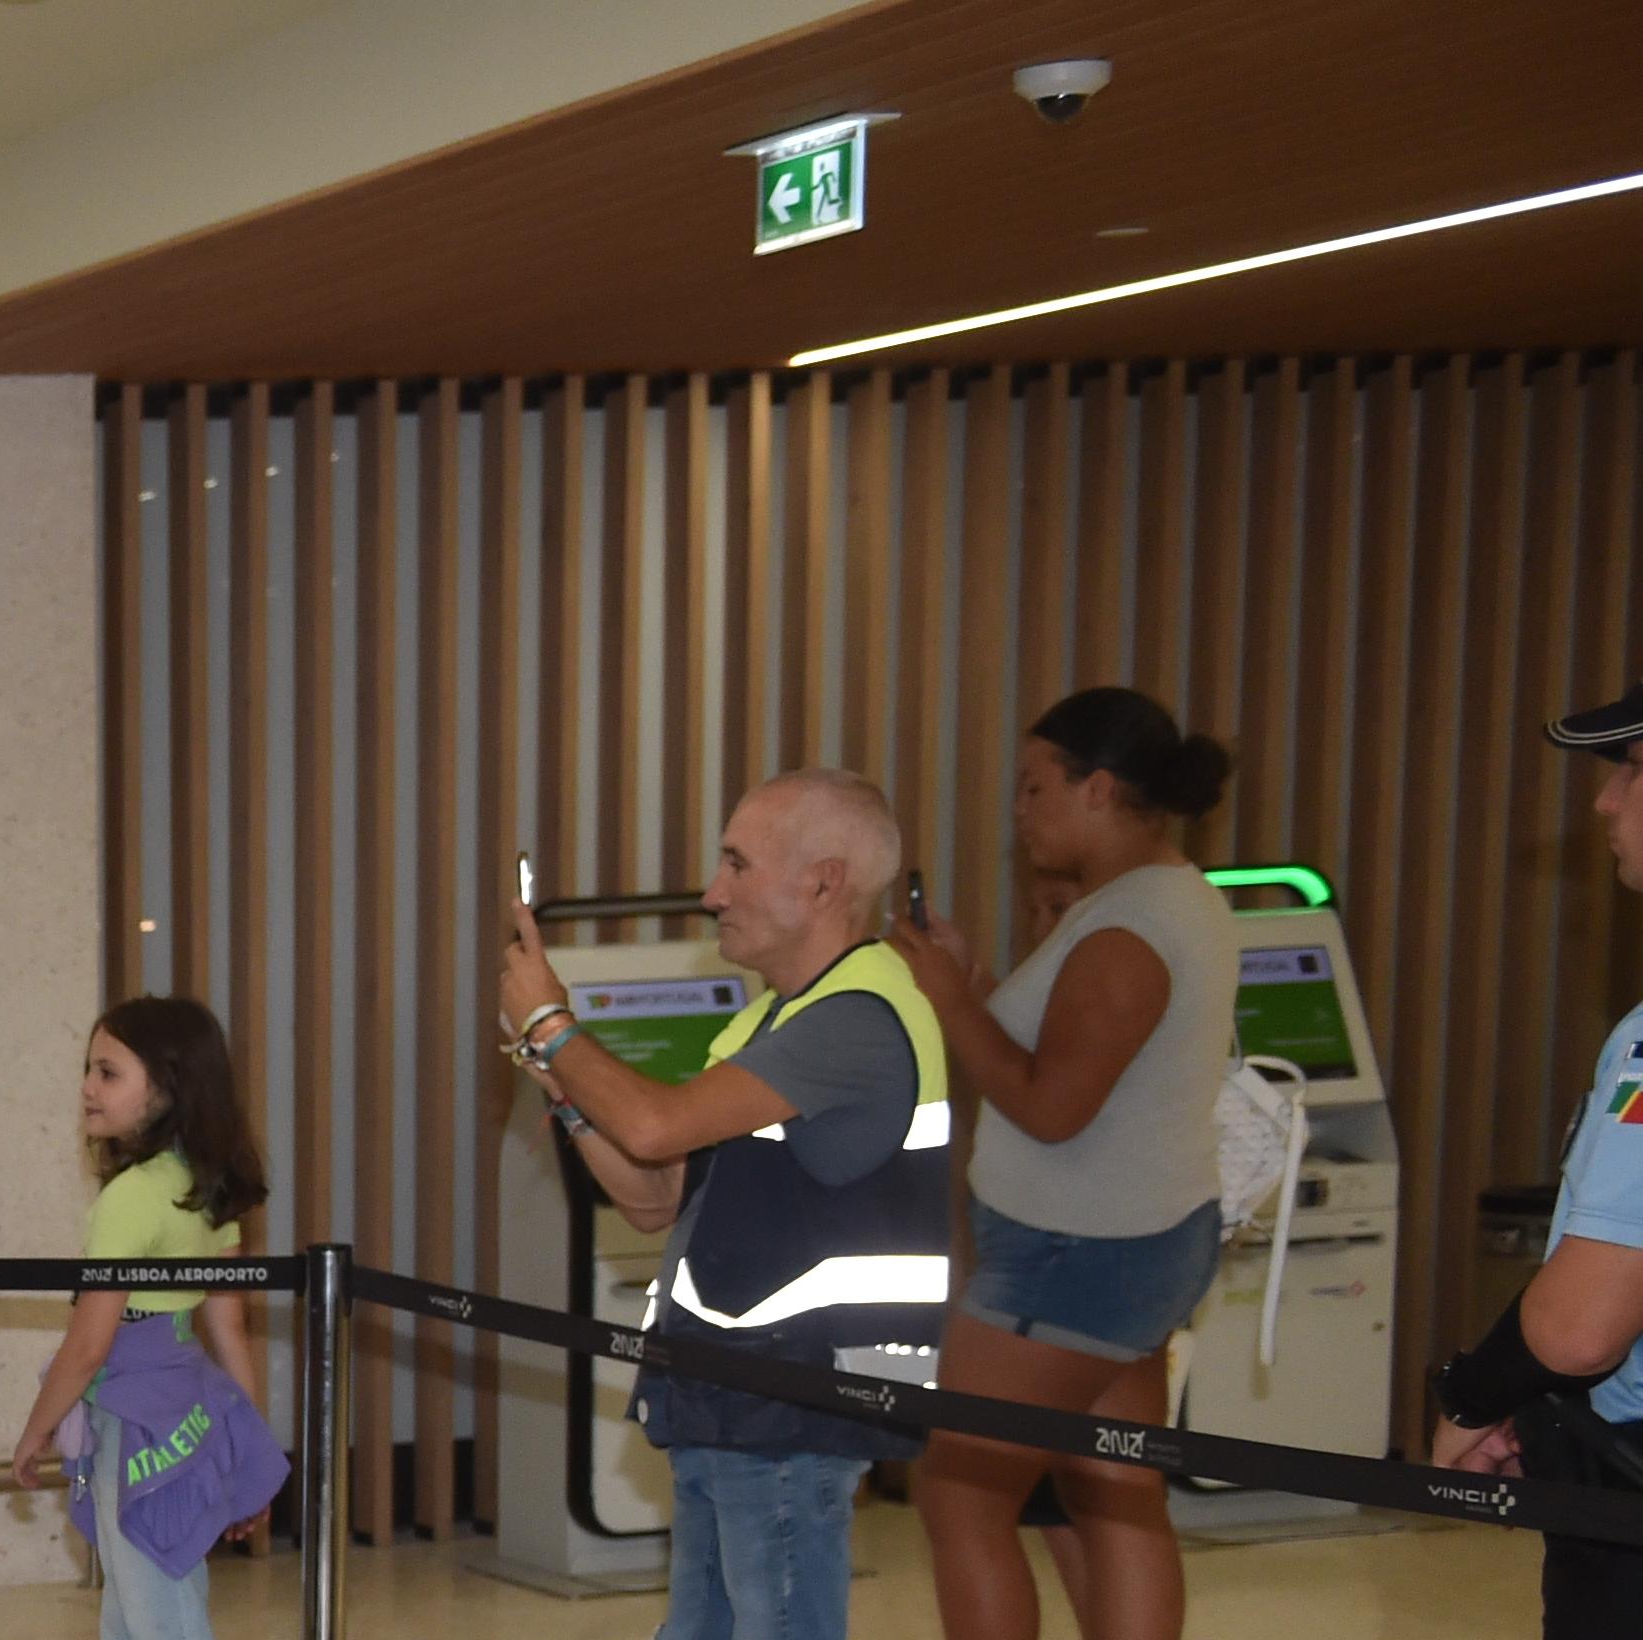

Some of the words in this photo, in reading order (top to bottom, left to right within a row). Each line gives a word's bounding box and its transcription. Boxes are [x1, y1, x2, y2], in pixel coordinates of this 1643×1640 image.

[117, 1267, 170, 1282] LISBOA
[174, 1267, 268, 1282] AEROPORTO
[836, 1384, 875, 1403] VINCI
[1428, 1484, 1486, 1504] VINCI
